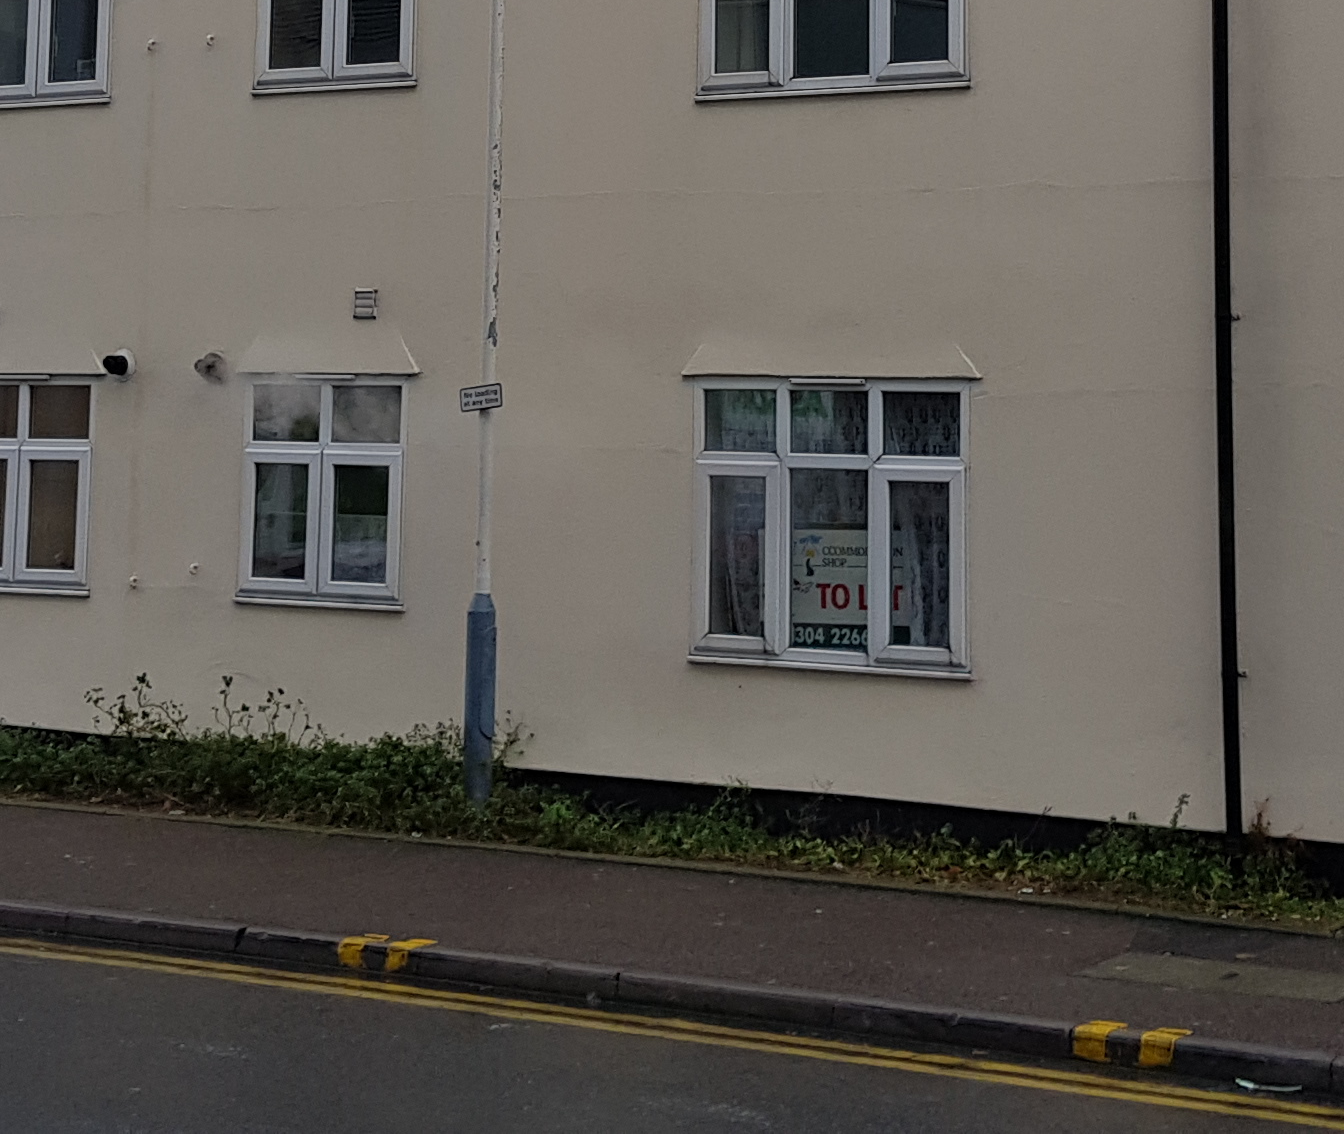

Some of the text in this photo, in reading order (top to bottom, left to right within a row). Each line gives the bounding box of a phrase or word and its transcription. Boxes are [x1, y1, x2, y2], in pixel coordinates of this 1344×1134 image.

[821, 557, 847, 568] SHOP
[816, 583, 904, 611] TO LT
